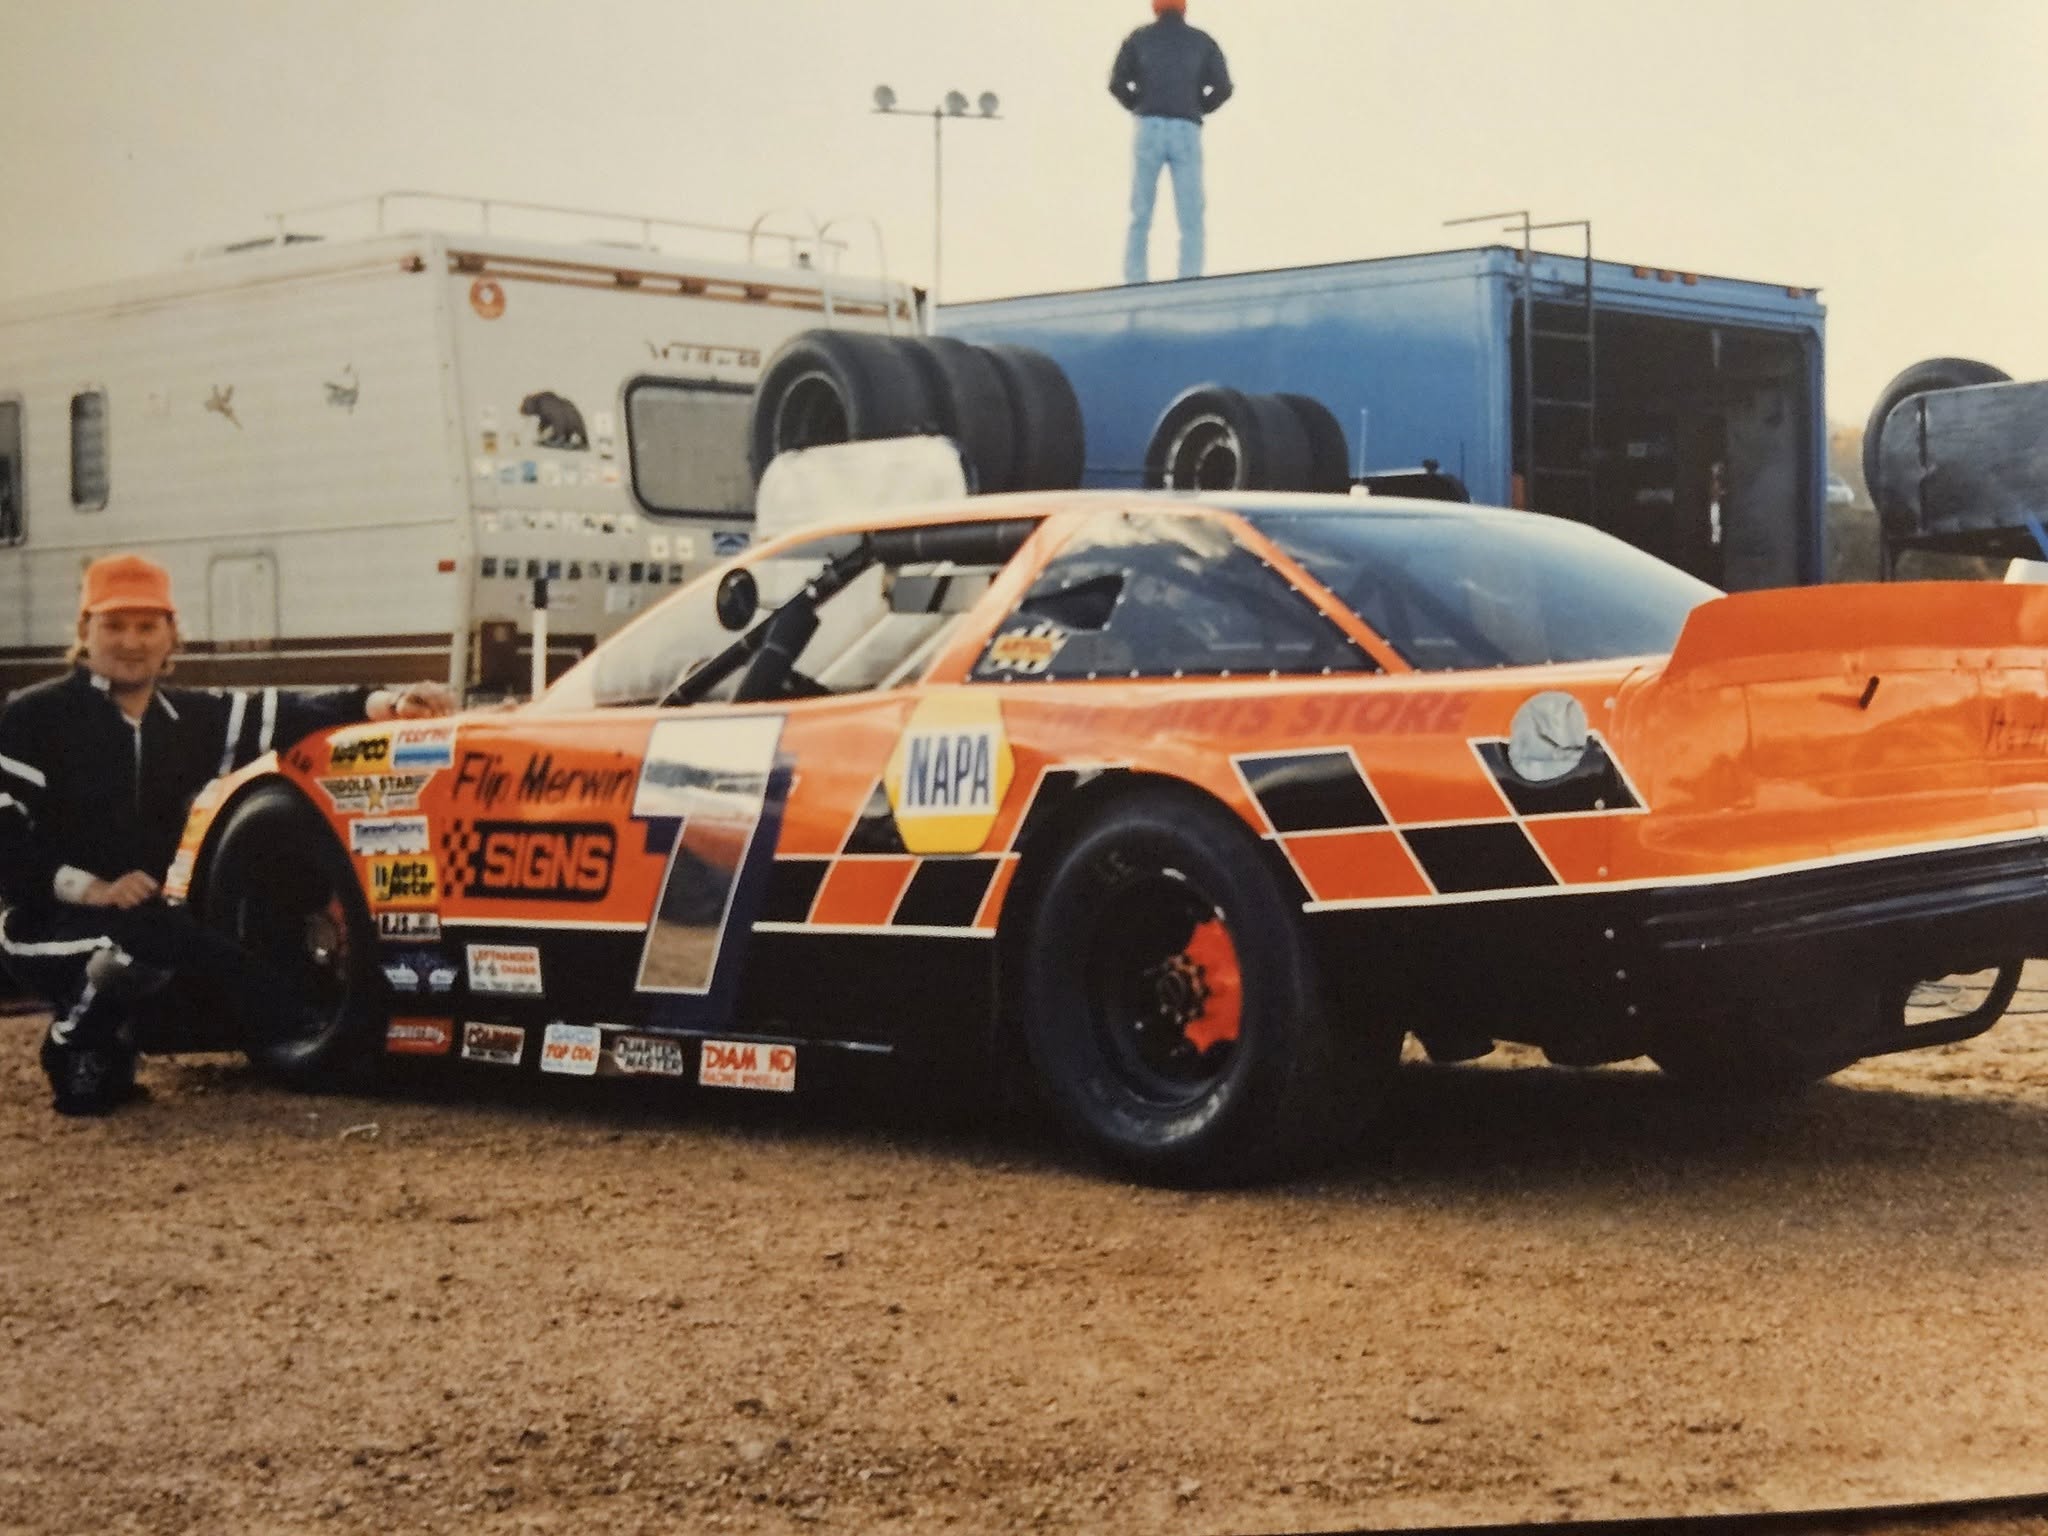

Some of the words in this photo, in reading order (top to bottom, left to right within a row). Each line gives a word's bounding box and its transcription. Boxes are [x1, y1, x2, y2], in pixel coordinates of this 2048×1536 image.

[1286, 690, 1476, 736] STORE
[379, 775, 414, 791] STAR
[452, 751, 512, 812] Flip
[517, 752, 633, 805] Merwin
[907, 734, 990, 806] NAPA
[390, 862, 428, 880] Auto
[480, 830, 613, 891] SIGNS
[632, 715, 786, 995] 7
[387, 881, 434, 898] Meter
[704, 1045, 795, 1073] DIAMND
